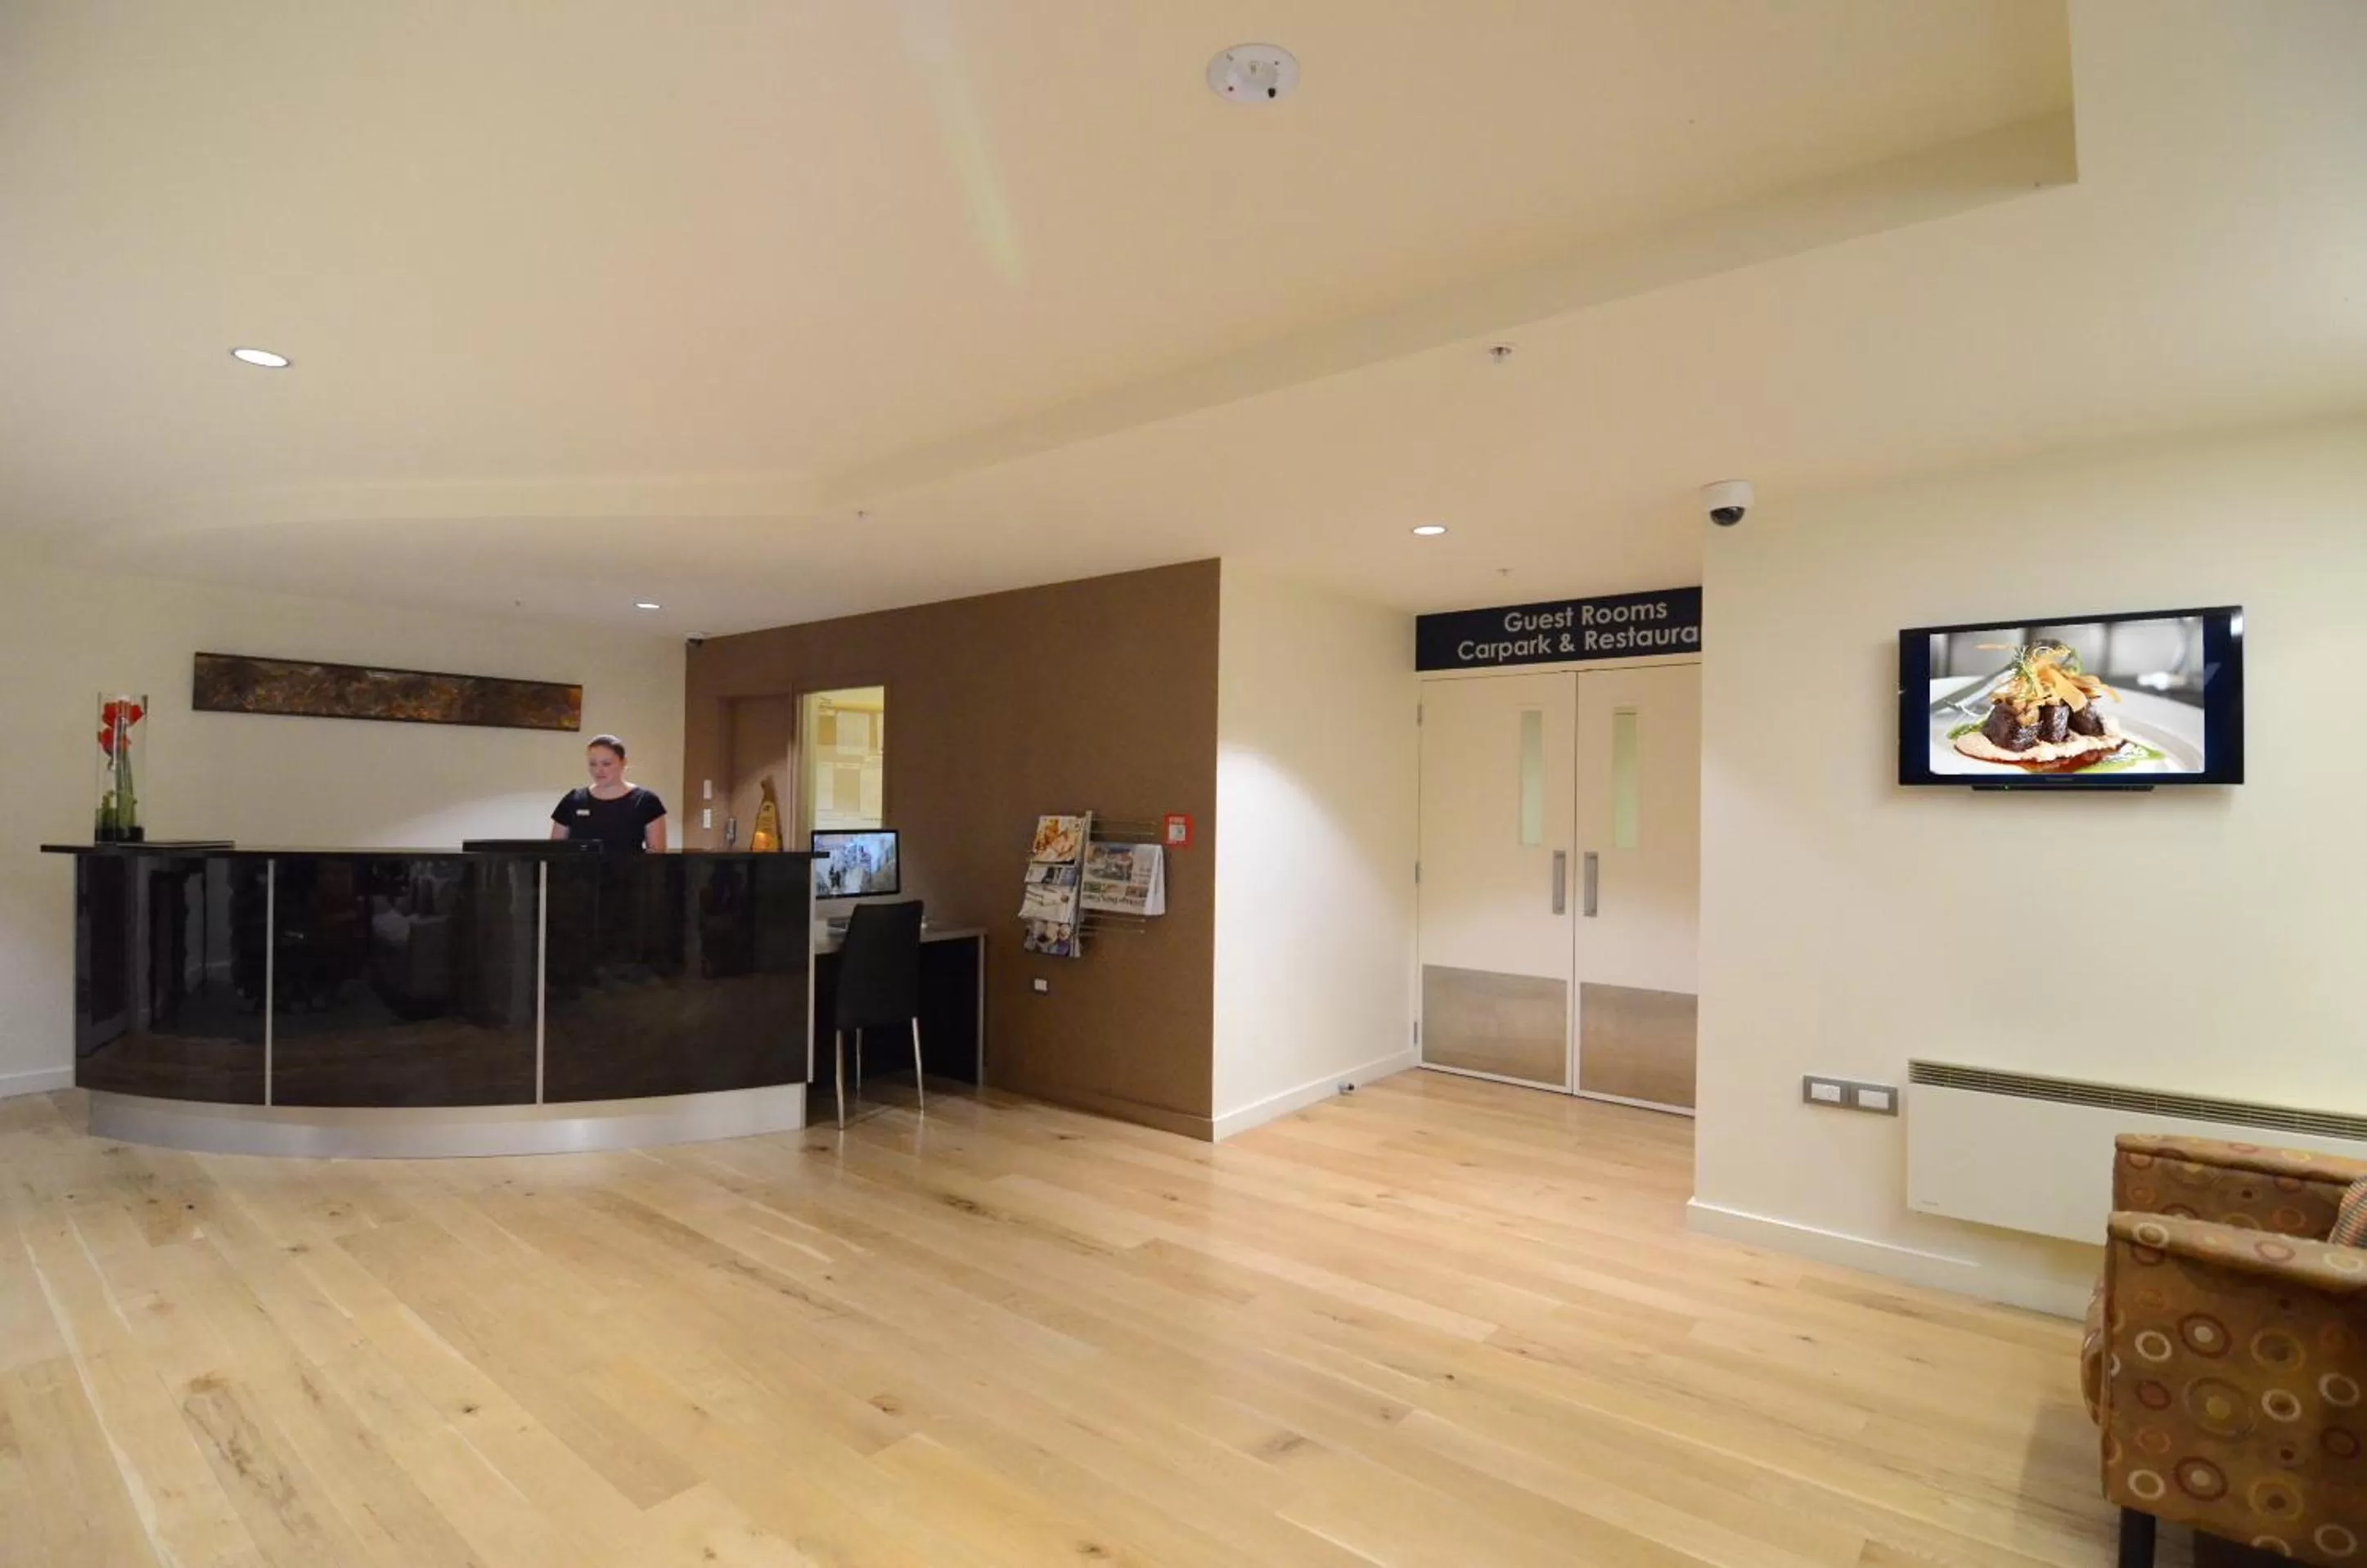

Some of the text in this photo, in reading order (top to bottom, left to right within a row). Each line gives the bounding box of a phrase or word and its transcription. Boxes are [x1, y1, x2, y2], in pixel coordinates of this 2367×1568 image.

[1504, 601, 1667, 632] Guest Rooms
[1457, 635, 1551, 662] Carpark
[1558, 633, 1576, 653] &
